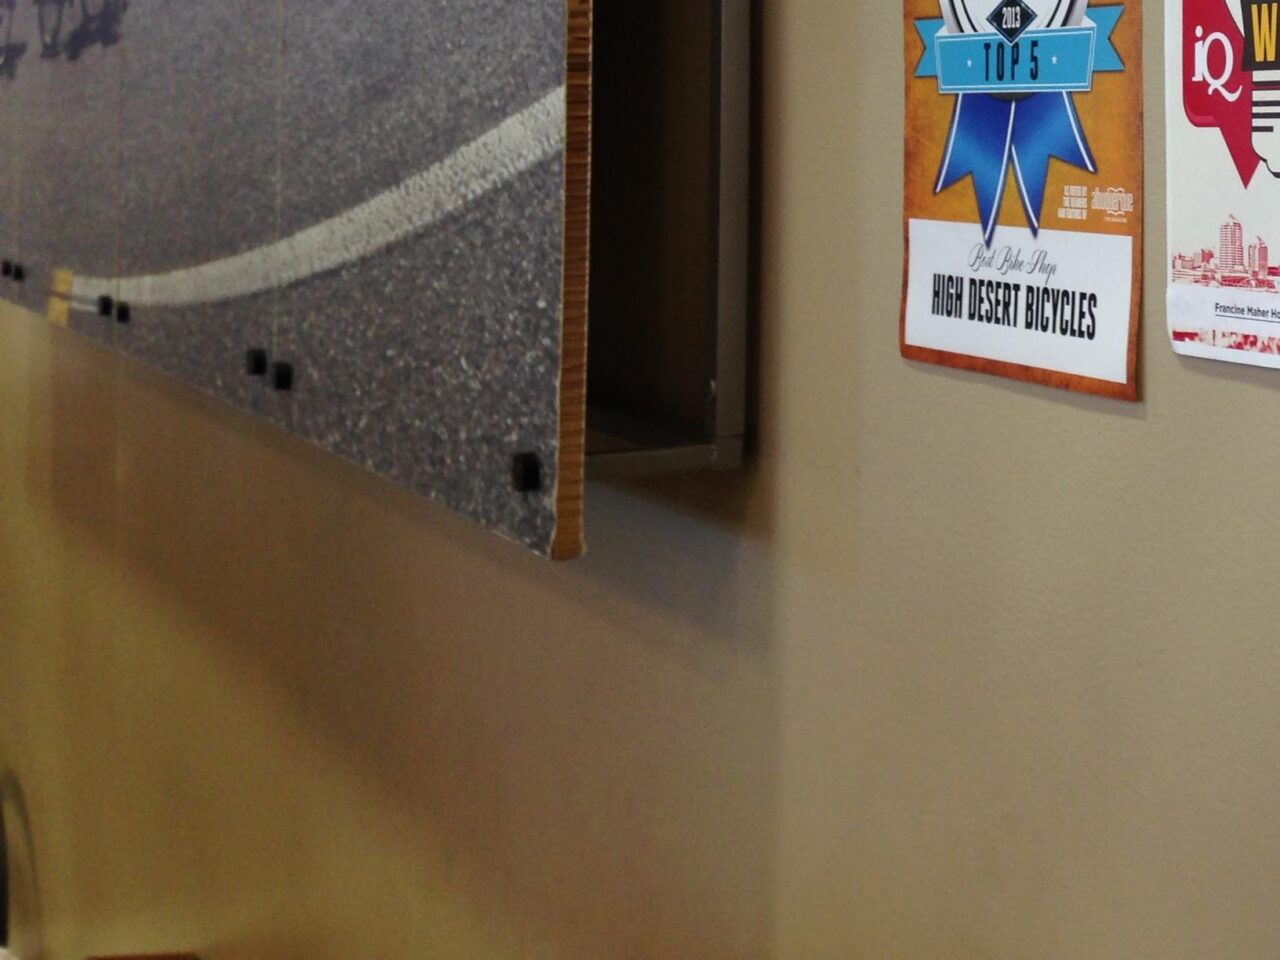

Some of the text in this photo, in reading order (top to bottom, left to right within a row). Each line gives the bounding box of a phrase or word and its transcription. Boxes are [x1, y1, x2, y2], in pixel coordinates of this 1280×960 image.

[1002, 6, 1021, 29] 2013
[983, 40, 1039, 82] TOP 5
[1191, 25, 1243, 102] iQ
[968, 242, 1058, 285] Best Bike Shop
[931, 272, 1098, 341] HIGH DESERT BICYCLES
[1214, 302, 1246, 316] Francine
[1247, 305, 1270, 318] Maher
